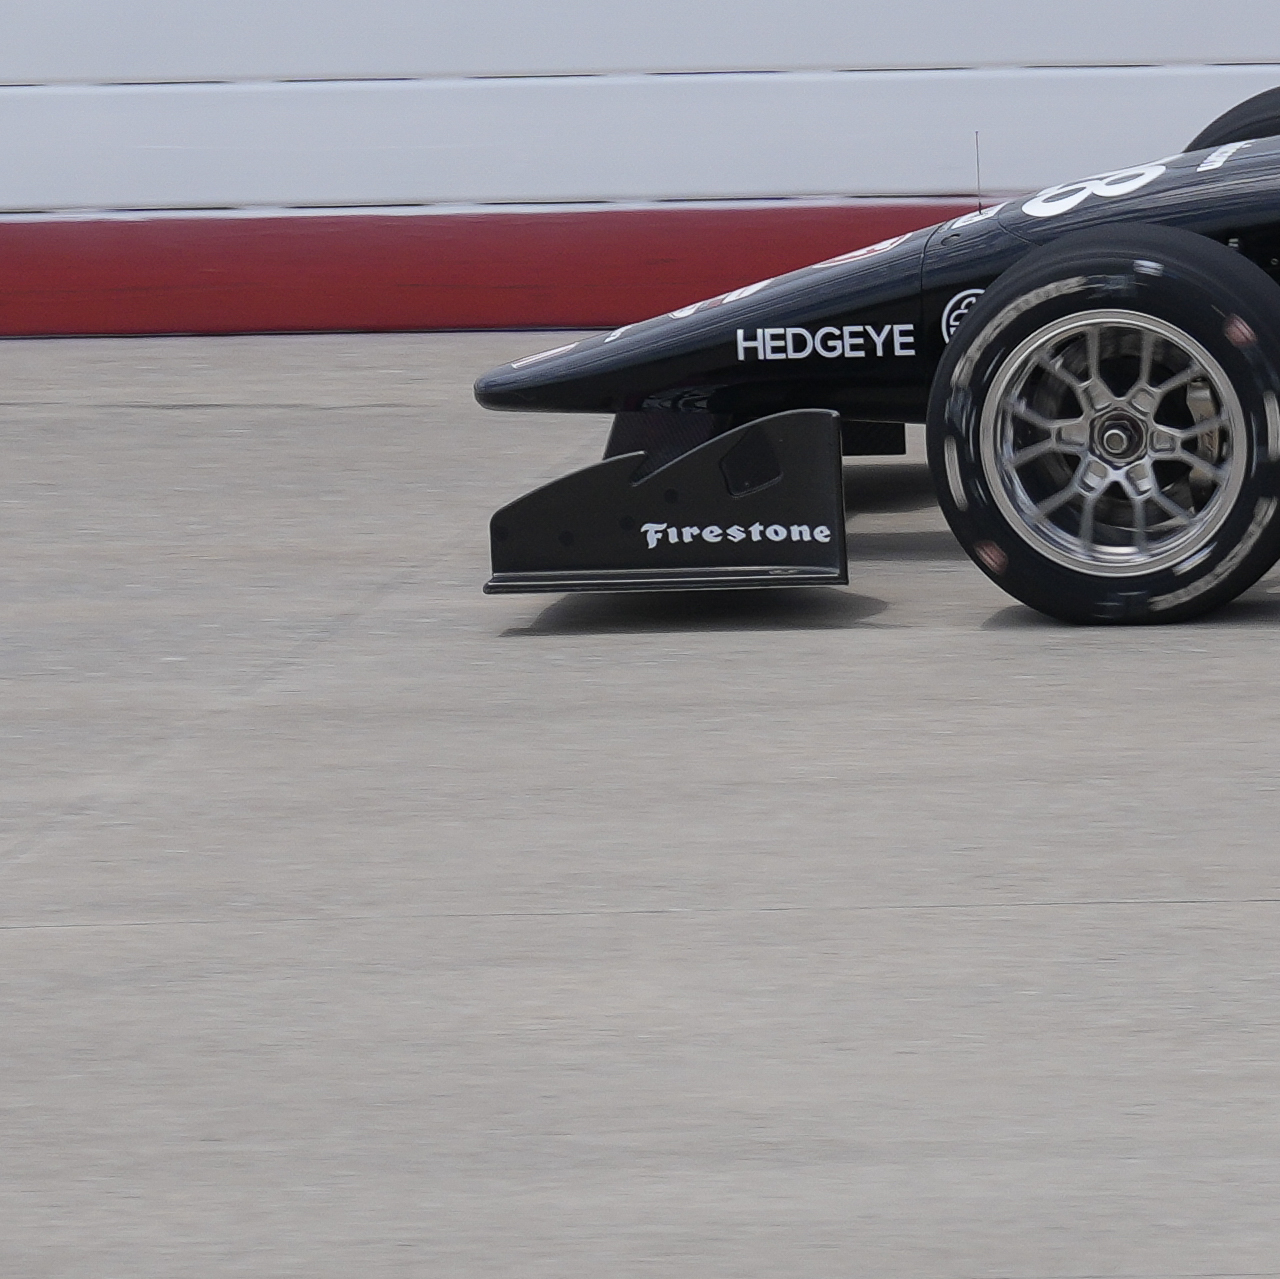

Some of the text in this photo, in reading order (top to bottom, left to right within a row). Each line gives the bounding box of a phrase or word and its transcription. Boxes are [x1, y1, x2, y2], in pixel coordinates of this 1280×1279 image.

[1021, 164, 1167, 217] 8
[736, 324, 916, 361] HEDGEYE
[641, 522, 832, 549] Firestone
